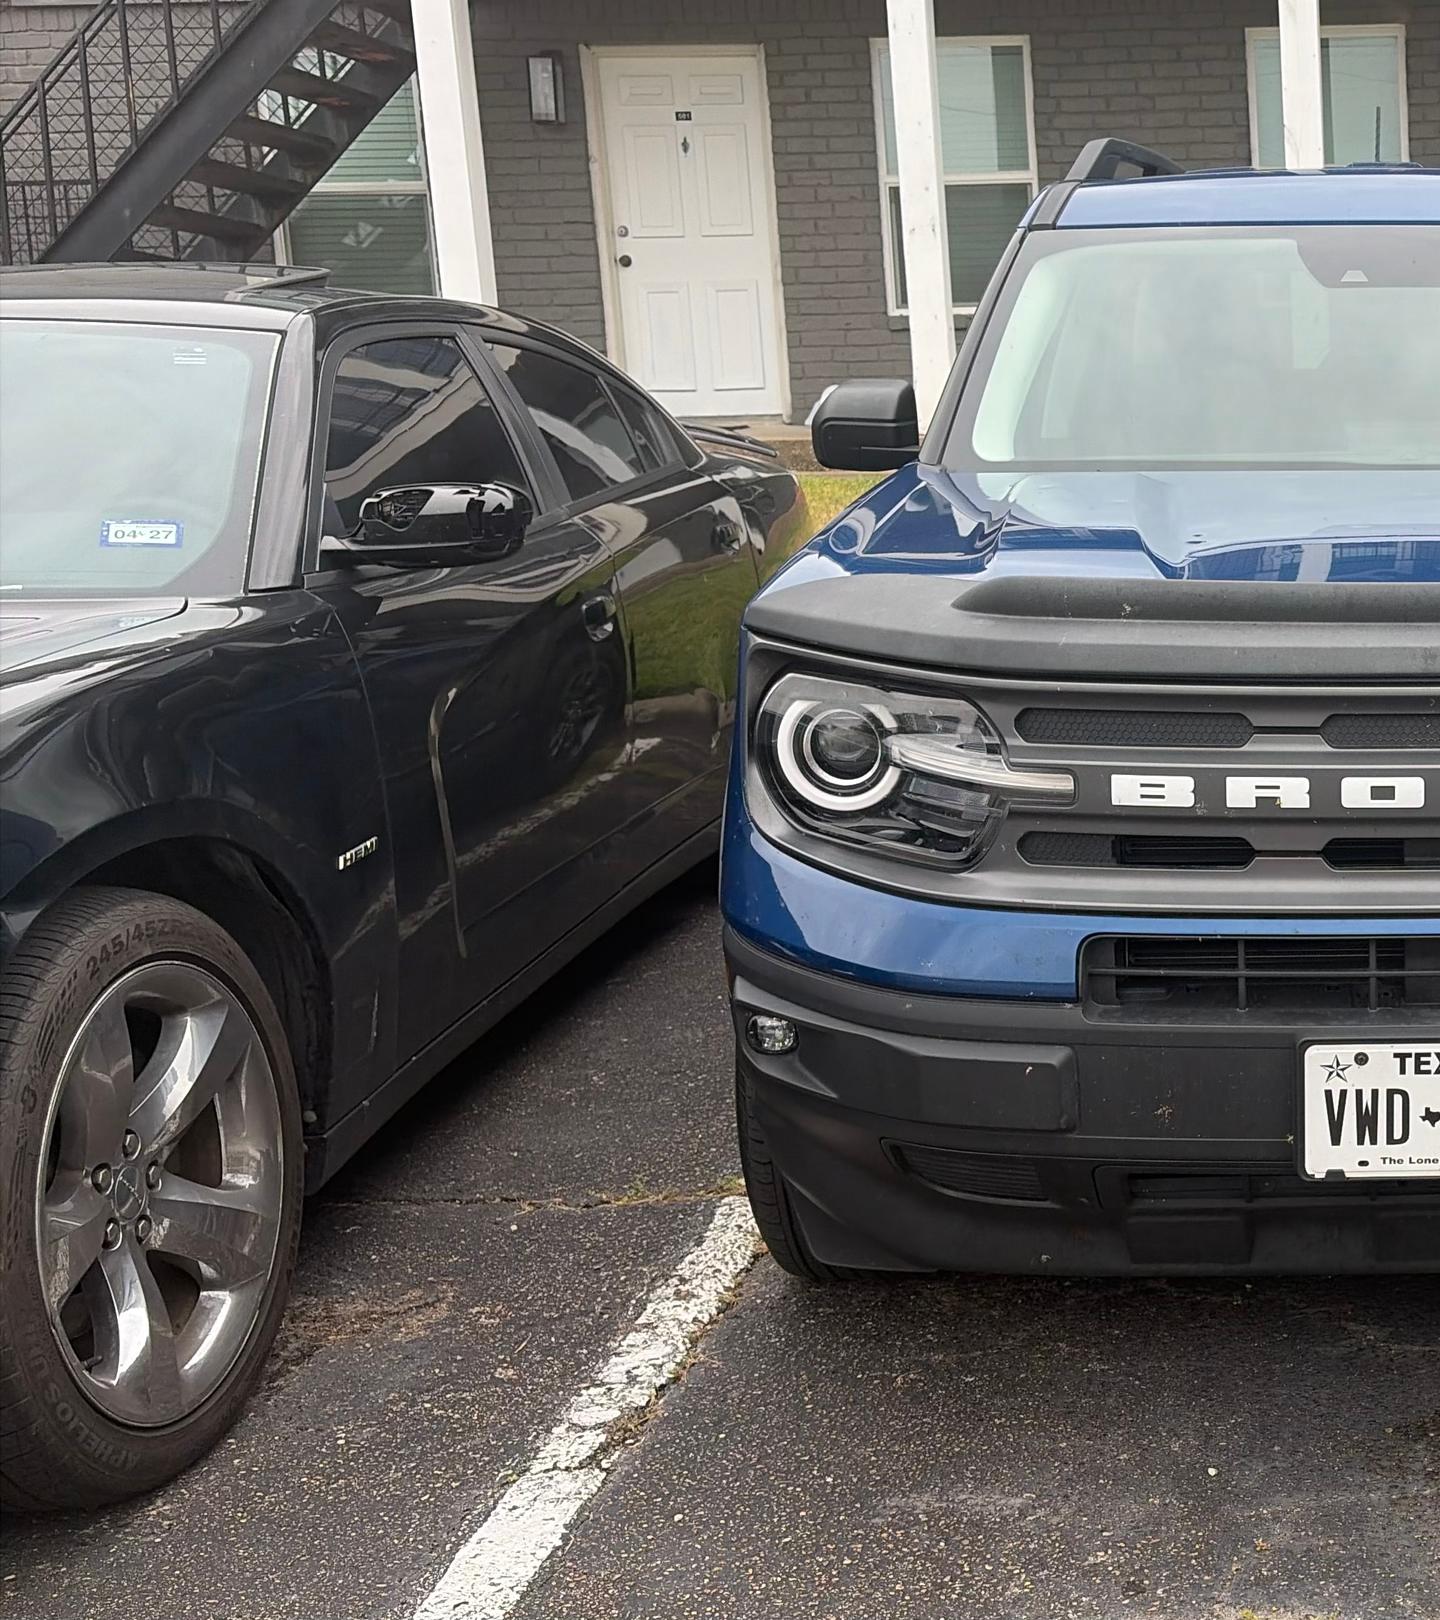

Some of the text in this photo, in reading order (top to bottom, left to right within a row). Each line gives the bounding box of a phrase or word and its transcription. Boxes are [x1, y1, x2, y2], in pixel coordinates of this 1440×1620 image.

[114, 529, 174, 540] 04 27
[1324, 1088, 1410, 1147] VWD
[1380, 1156, 1404, 1165] The
[1408, 1156, 1440, 1165] Lone
